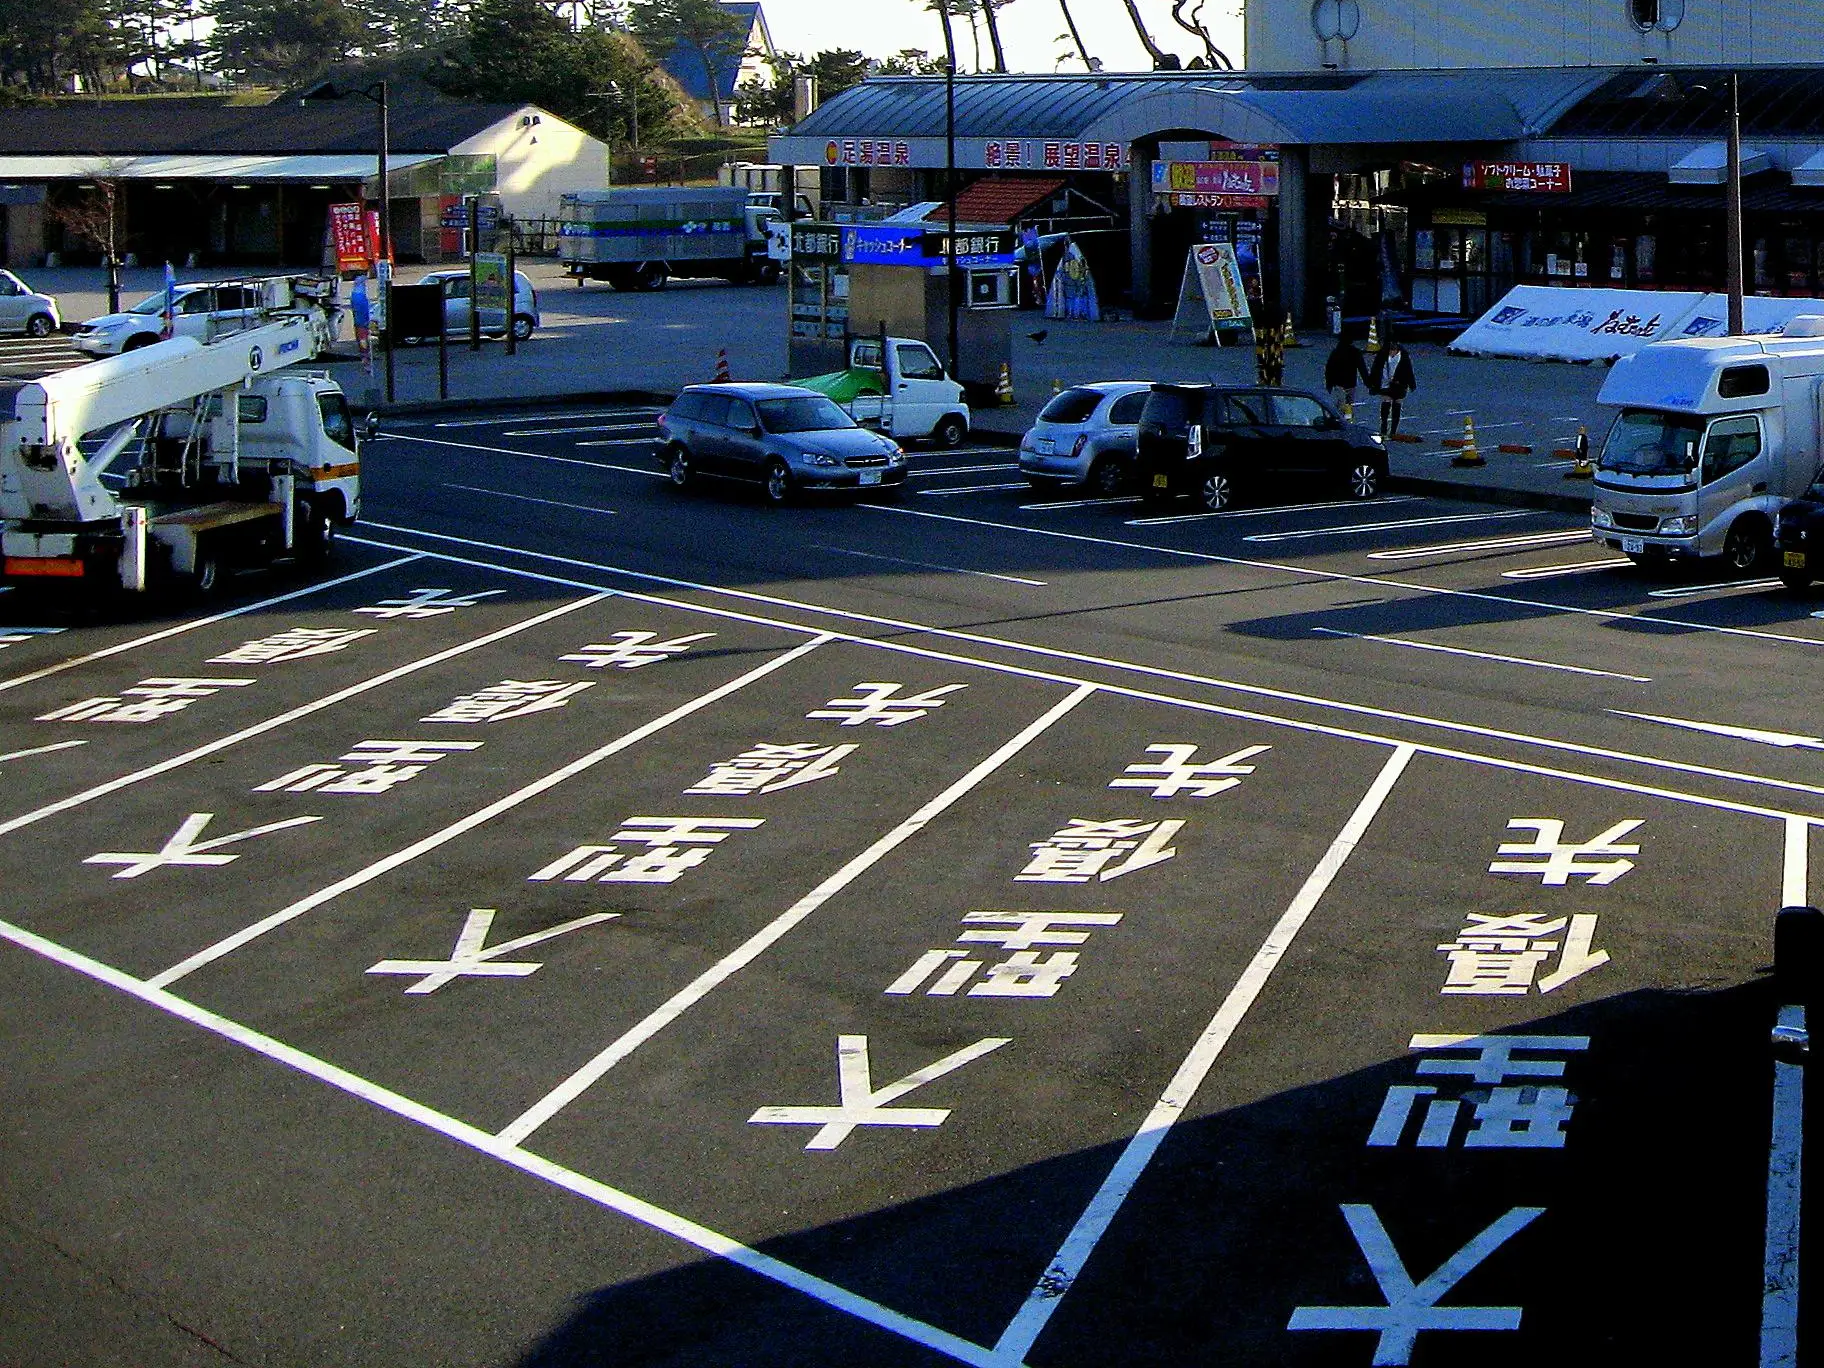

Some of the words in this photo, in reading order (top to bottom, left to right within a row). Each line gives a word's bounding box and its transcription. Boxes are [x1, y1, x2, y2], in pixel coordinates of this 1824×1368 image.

[841, 139, 912, 166] 足湯温泉
[793, 233, 840, 255] 北都銀行
